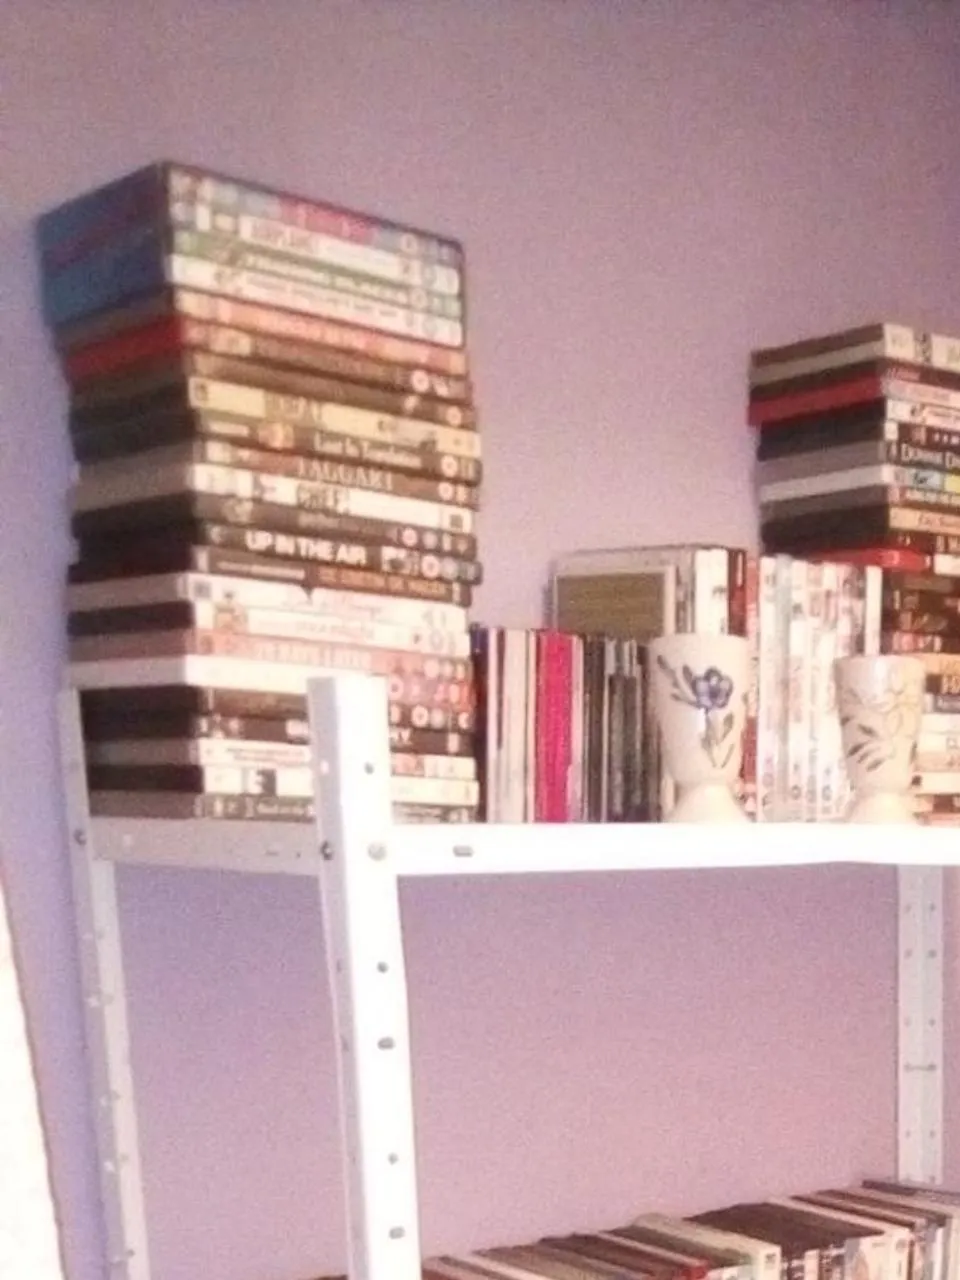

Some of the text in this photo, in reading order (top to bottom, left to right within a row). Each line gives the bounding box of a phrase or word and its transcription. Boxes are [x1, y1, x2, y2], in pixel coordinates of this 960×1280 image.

[245, 530, 368, 566] UP IN THE AIR
